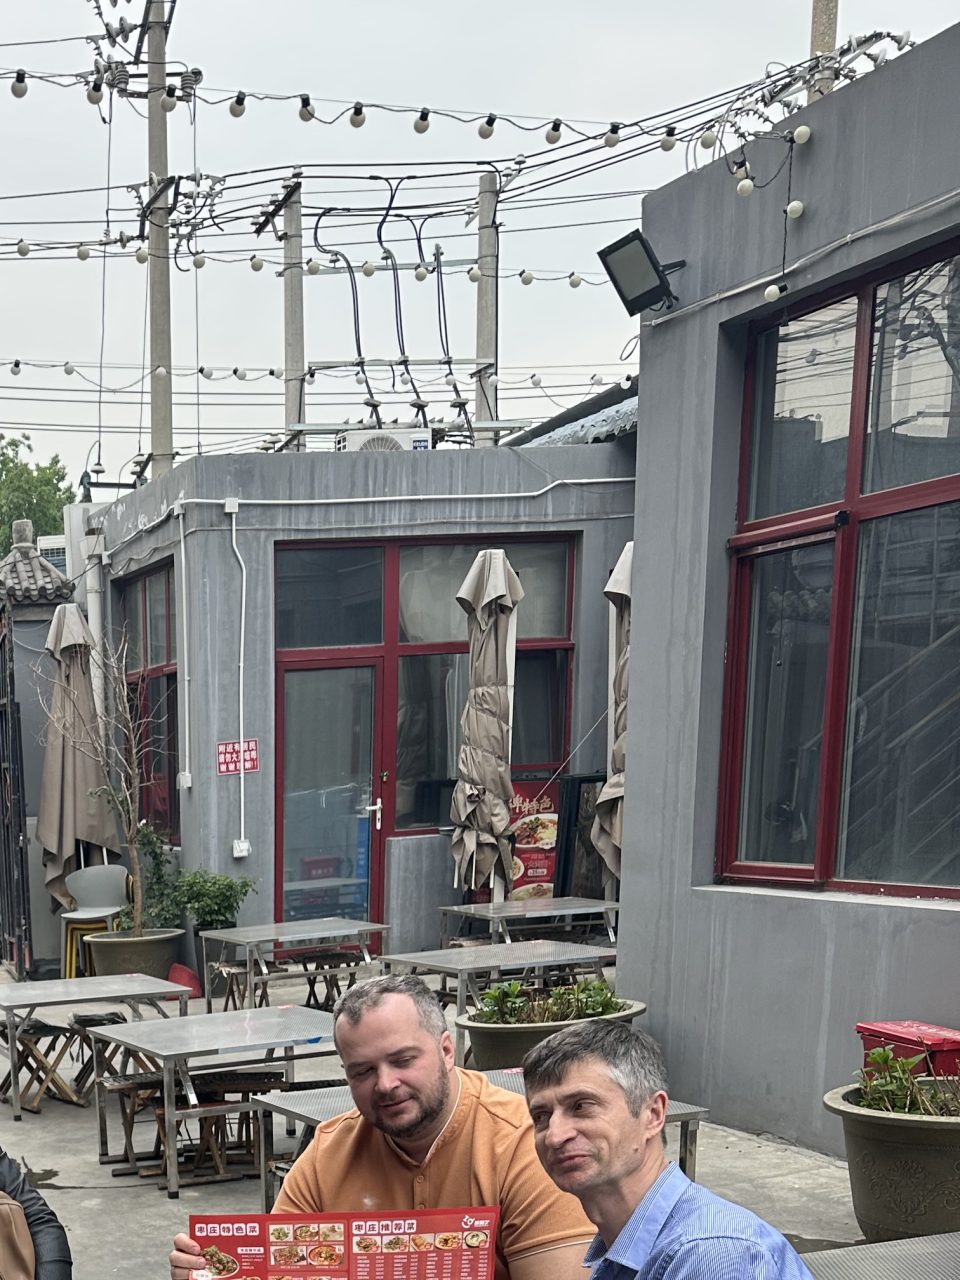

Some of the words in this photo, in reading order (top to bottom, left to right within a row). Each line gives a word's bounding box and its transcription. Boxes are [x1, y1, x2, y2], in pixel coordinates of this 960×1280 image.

[196, 1224, 258, 1235] 枣庄特色菜
[353, 1221, 416, 1233] 枣庄推荐菜
